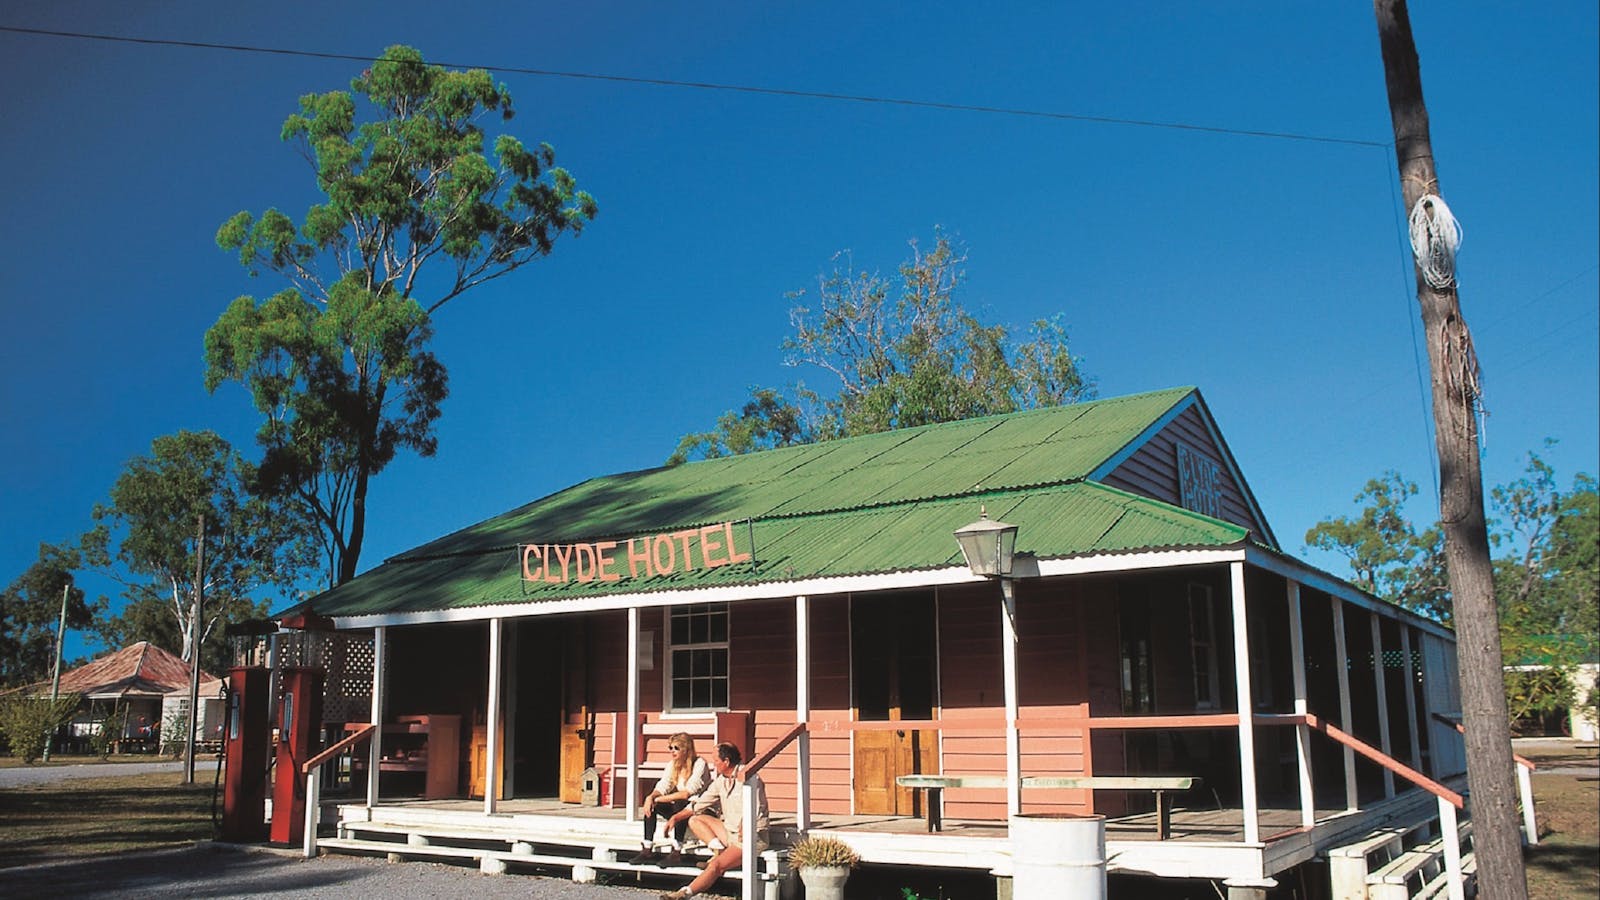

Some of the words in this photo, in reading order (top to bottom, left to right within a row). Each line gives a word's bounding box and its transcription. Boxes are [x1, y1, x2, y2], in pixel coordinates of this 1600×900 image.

[1179, 446, 1221, 497] CLYDE
[523, 541, 620, 583] CLYDE
[627, 521, 750, 578] HOTEL
